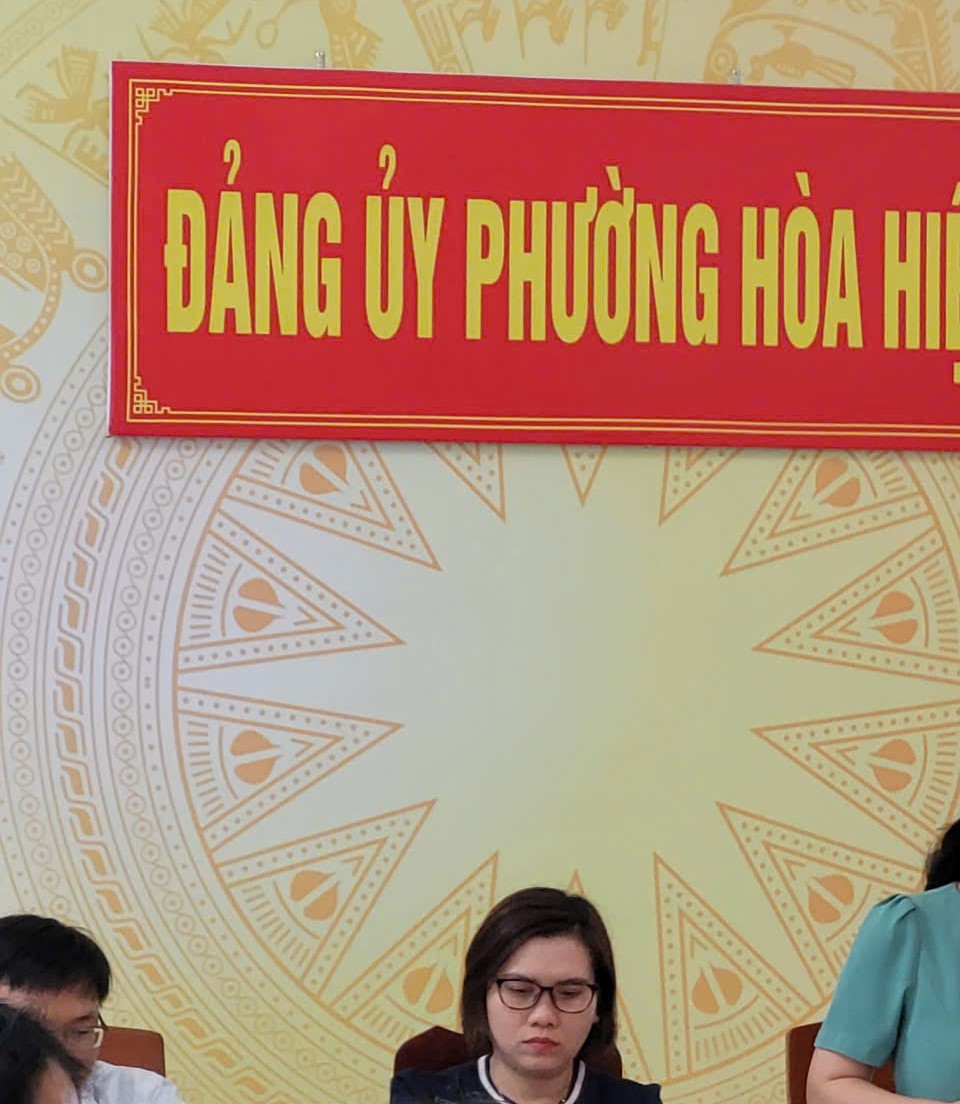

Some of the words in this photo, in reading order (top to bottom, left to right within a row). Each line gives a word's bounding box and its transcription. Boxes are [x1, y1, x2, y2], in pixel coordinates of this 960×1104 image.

[164, 140, 341, 337] ĐẢNG
[366, 145, 444, 339] ỦY
[466, 167, 720, 345] PHƯỜNG
[742, 172, 863, 349] HÒA
